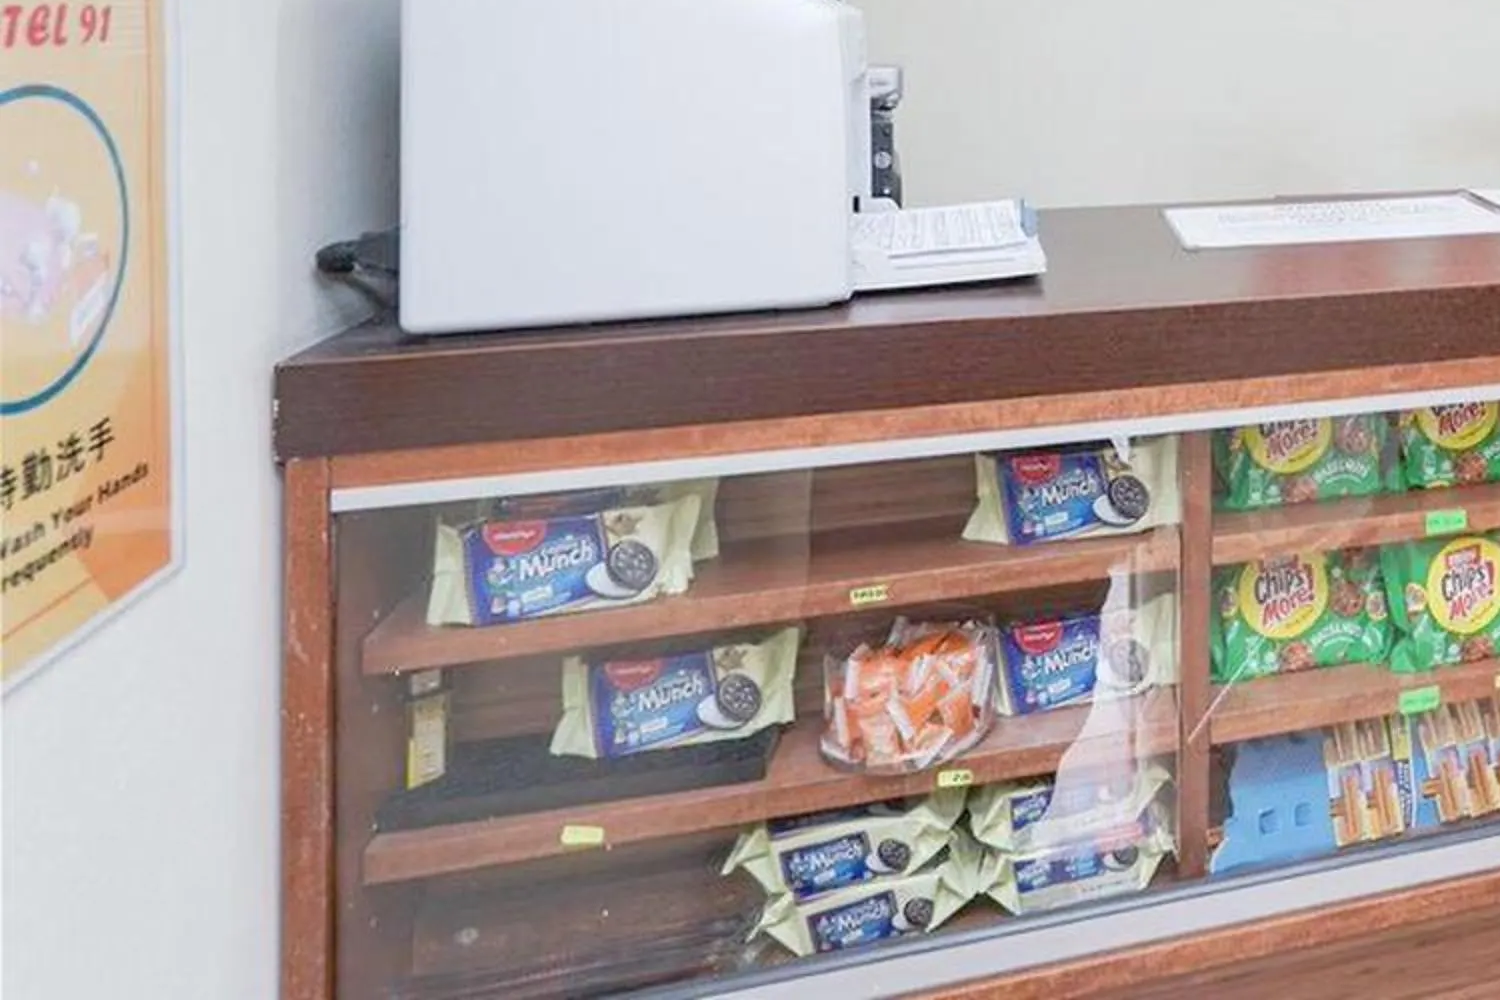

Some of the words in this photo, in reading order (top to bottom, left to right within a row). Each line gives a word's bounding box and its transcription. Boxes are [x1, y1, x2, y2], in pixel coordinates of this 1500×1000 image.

[79, 4, 112, 44] 91
[97, 462, 149, 504] Hands
[1041, 470, 1097, 506] Munch
[518, 539, 594, 582] Munch
[1254, 568, 1305, 605] Chips
[1441, 566, 1486, 601] Chips
[638, 676, 704, 713] Munch
